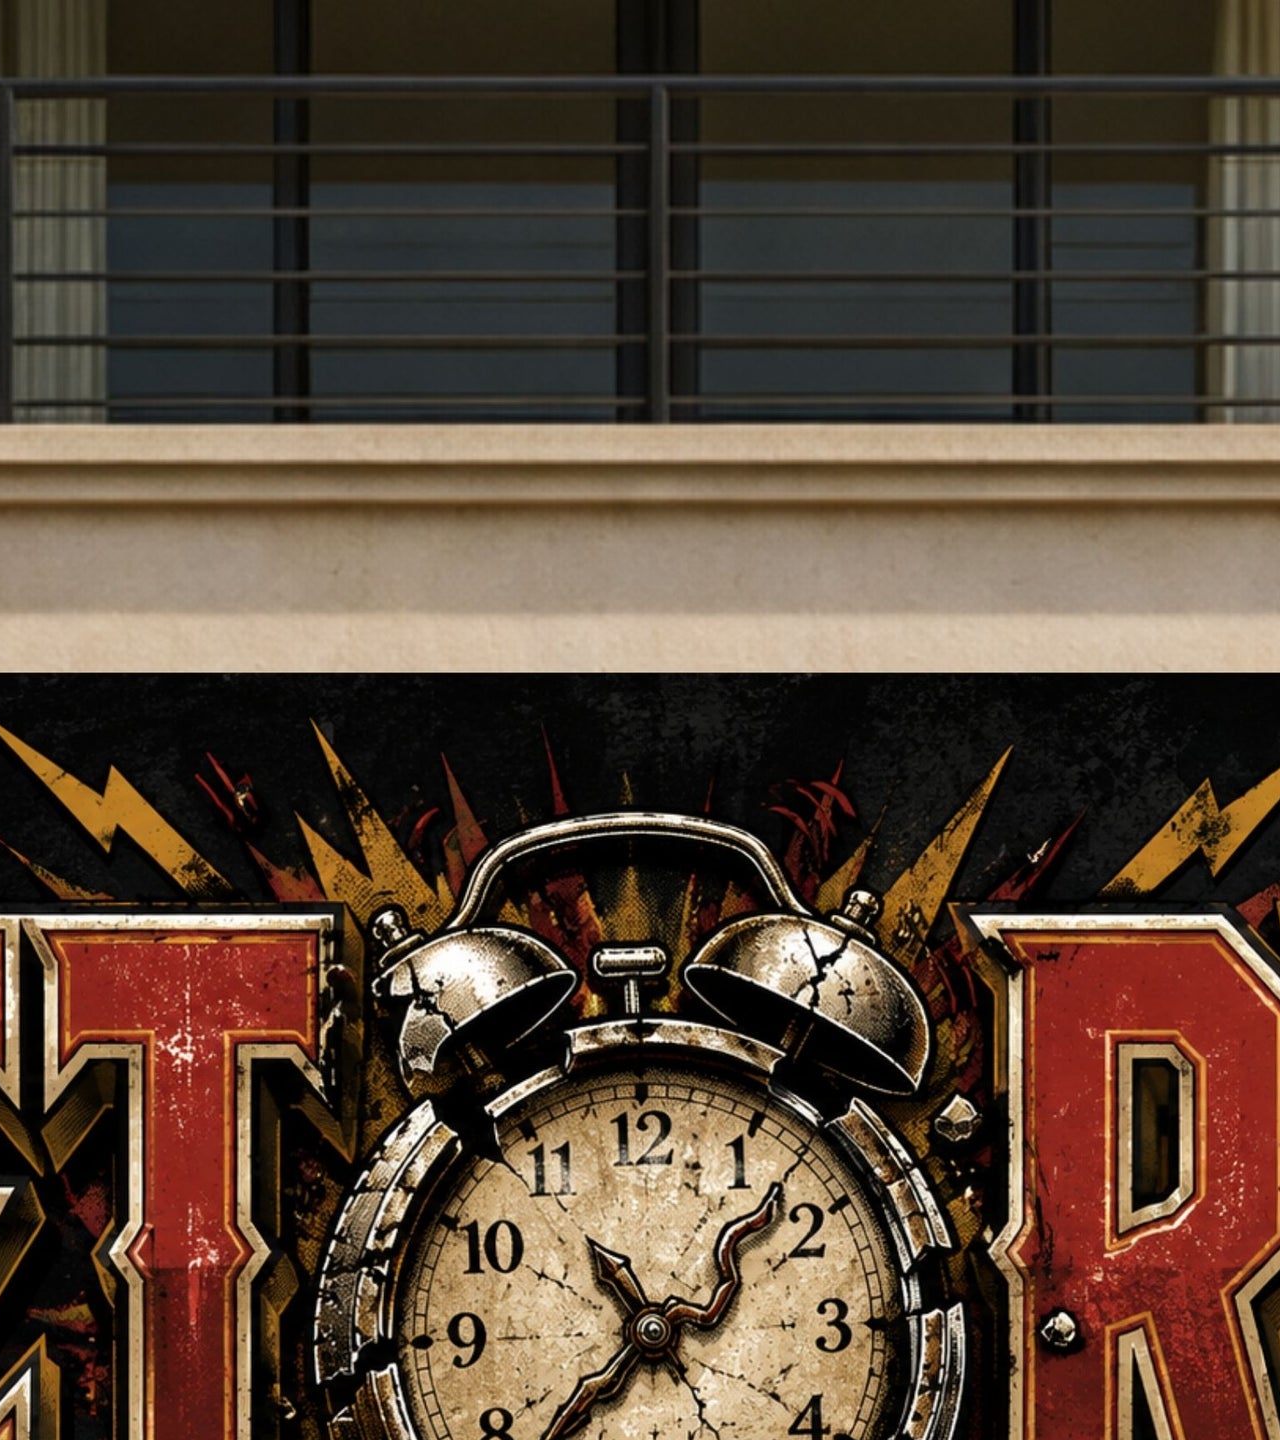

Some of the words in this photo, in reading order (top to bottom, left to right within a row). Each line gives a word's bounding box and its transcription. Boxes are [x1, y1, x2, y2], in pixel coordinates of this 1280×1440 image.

[609, 1109, 675, 1168] 12
[724, 1134, 753, 1191] 1
[527, 1140, 578, 1198] 11
[459, 1219, 524, 1275] 10
[787, 1201, 827, 1259] 2
[446, 1312, 487, 1369] 9
[814, 1297, 853, 1354] 3
